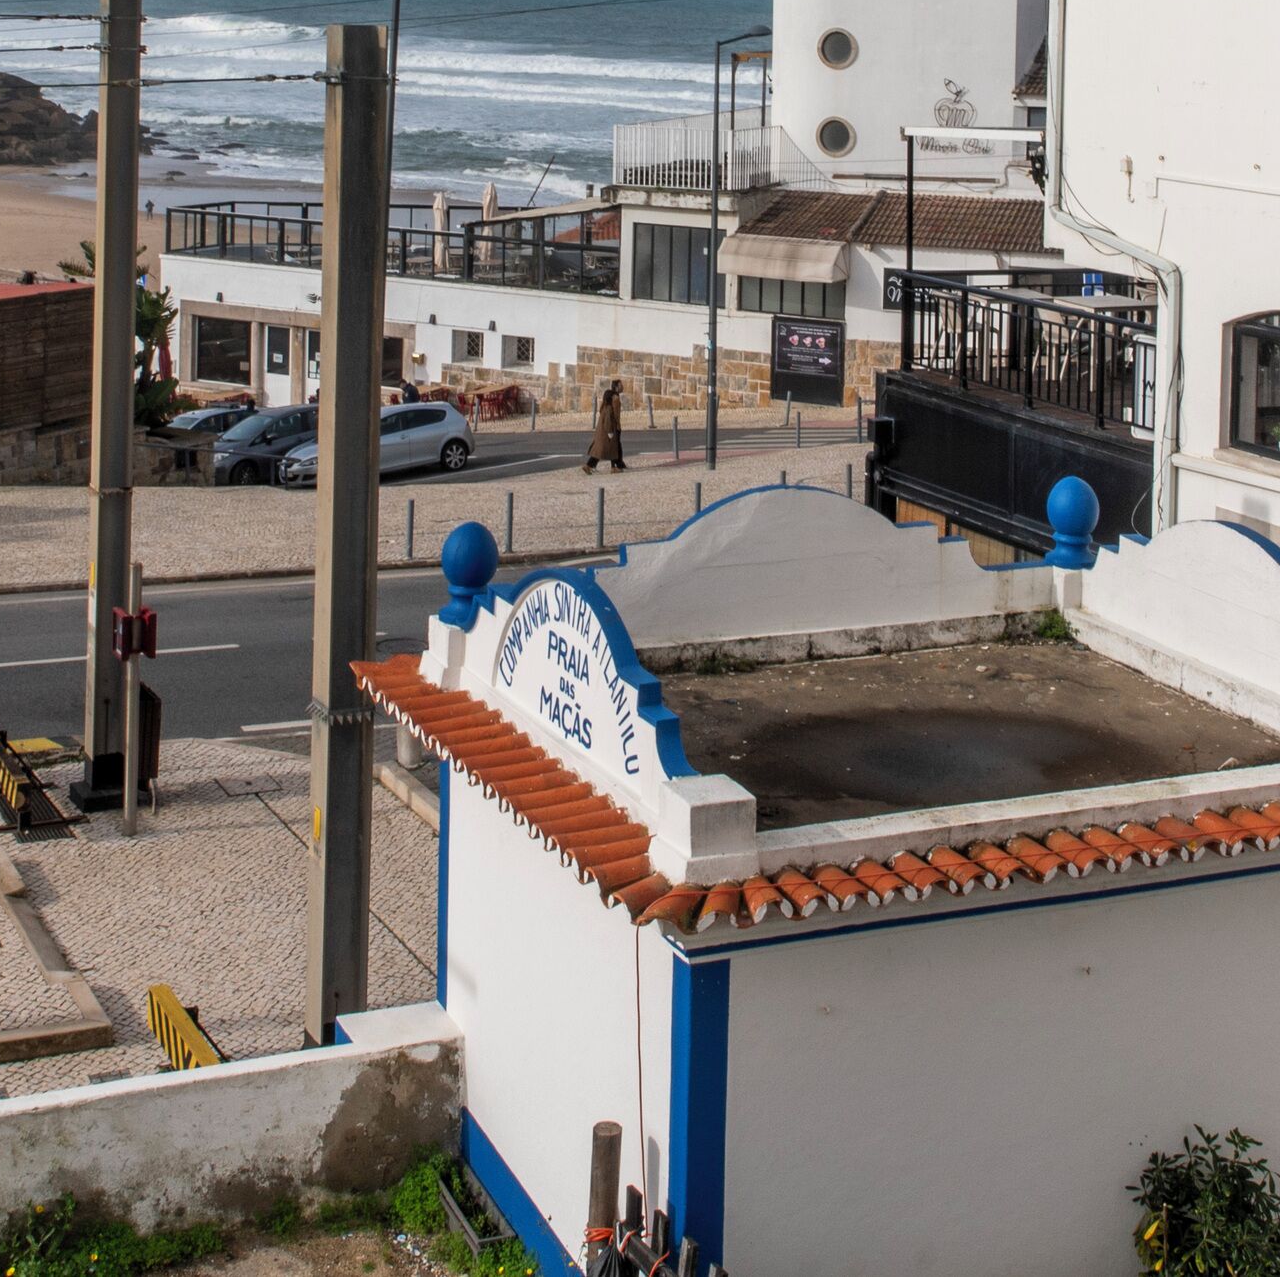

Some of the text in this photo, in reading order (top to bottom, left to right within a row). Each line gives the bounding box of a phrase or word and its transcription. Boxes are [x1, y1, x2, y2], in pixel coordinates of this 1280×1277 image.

[499, 588, 551, 687] COMPANHIA
[554, 582, 592, 644] SINTRA
[547, 629, 590, 686] PRAIA
[540, 685, 593, 749] MAÇÃS
[559, 676, 575, 700] DAS
